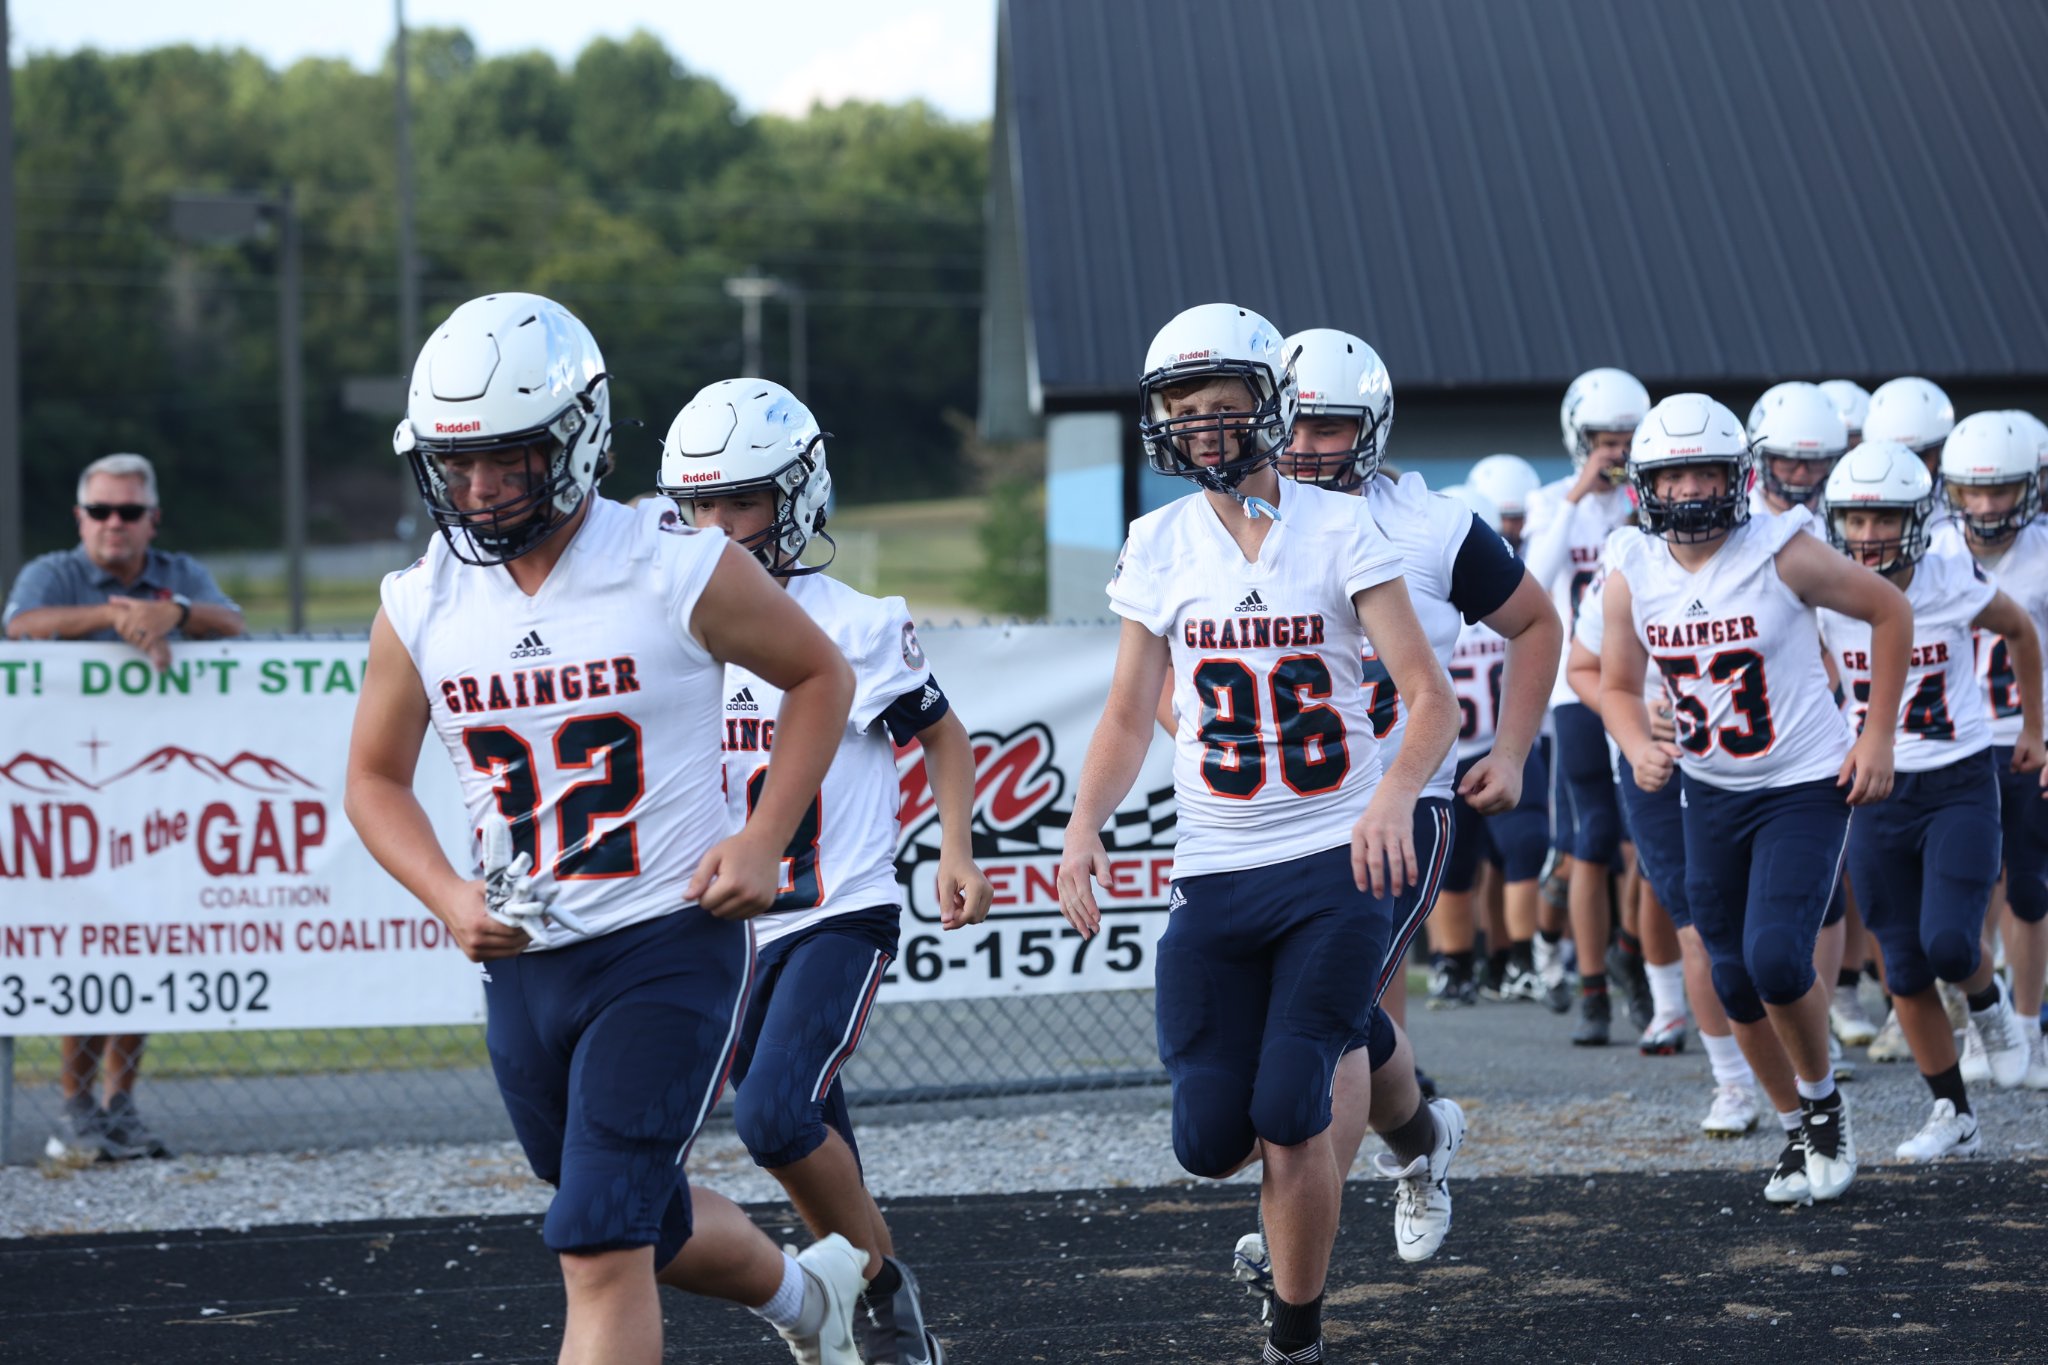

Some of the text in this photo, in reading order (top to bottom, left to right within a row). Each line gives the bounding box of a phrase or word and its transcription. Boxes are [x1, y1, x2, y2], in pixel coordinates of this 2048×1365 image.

[1179, 350, 1210, 361] Riddell
[435, 421, 481, 433] Riddell
[682, 471, 721, 483] Riddell
[1234, 603, 1268, 612] adidas
[1184, 614, 1325, 649] GRAINGER
[1647, 615, 1759, 648] GRAINGER
[510, 647, 552, 659] adidas
[1843, 643, 1949, 671] GRGER
[81, 659, 240, 695] DON'T
[259, 659, 368, 695] STA
[441, 655, 641, 714] GRAINGER
[726, 700, 759, 711] adidas
[1652, 648, 1776, 759] 53
[1192, 653, 1351, 800] 86
[462, 711, 645, 881] 32
[0, 799, 327, 880] ND in the GAP
[200, 885, 331, 908] COALITION
[0, 924, 68, 957] NTY
[81, 920, 284, 957] PREVENTION
[881, 920, 1143, 985] 6-1575
[2, 970, 271, 1018] 3-300-1302
